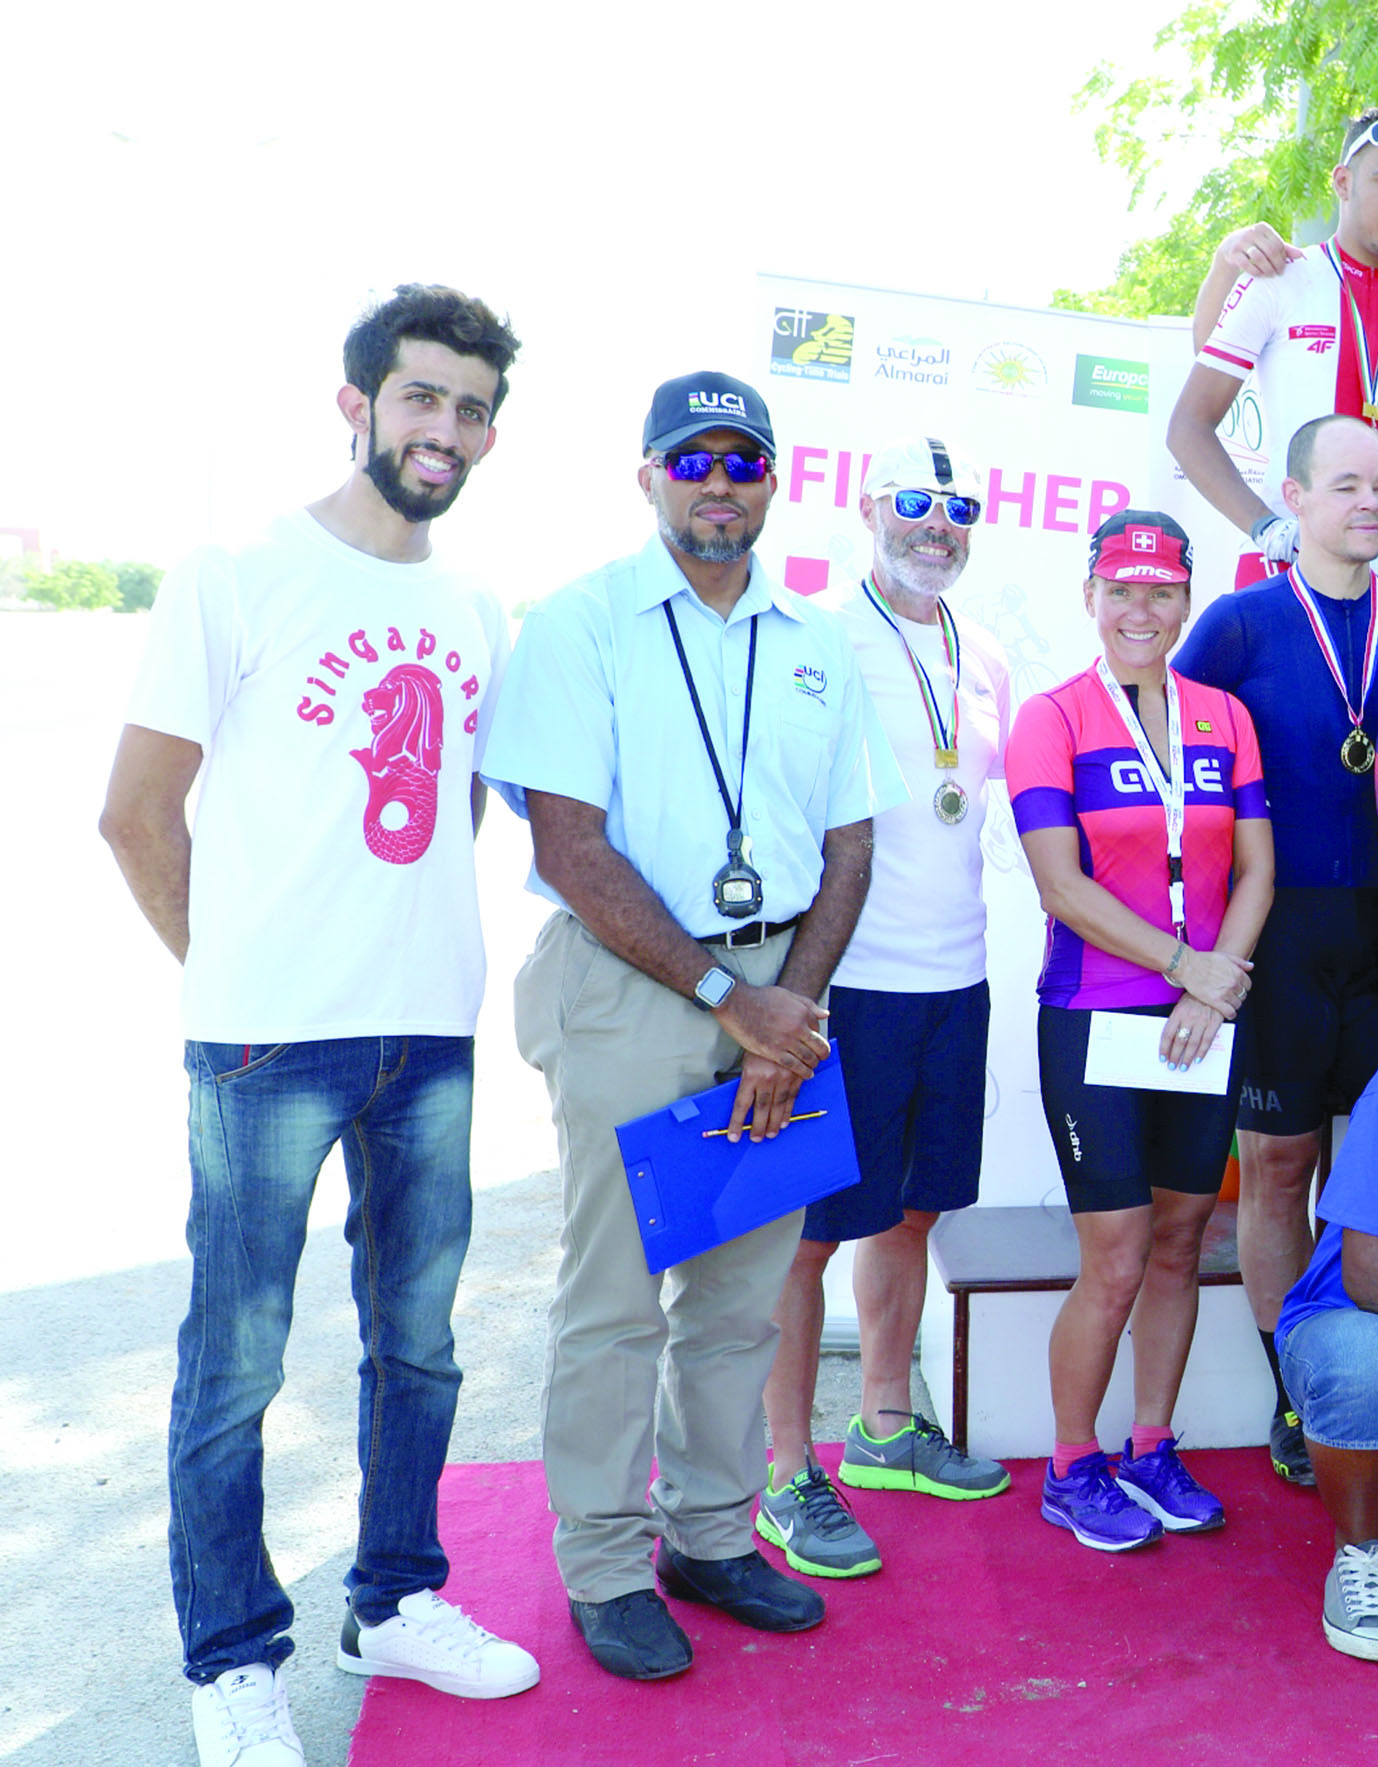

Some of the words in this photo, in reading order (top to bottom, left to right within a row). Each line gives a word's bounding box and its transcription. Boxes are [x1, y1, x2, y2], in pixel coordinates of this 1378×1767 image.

[874, 363, 949, 385] Almarai
[700, 391, 745, 412] UCI
[788, 445, 1131, 534] FIHER
[1114, 565, 1173, 580] BMC
